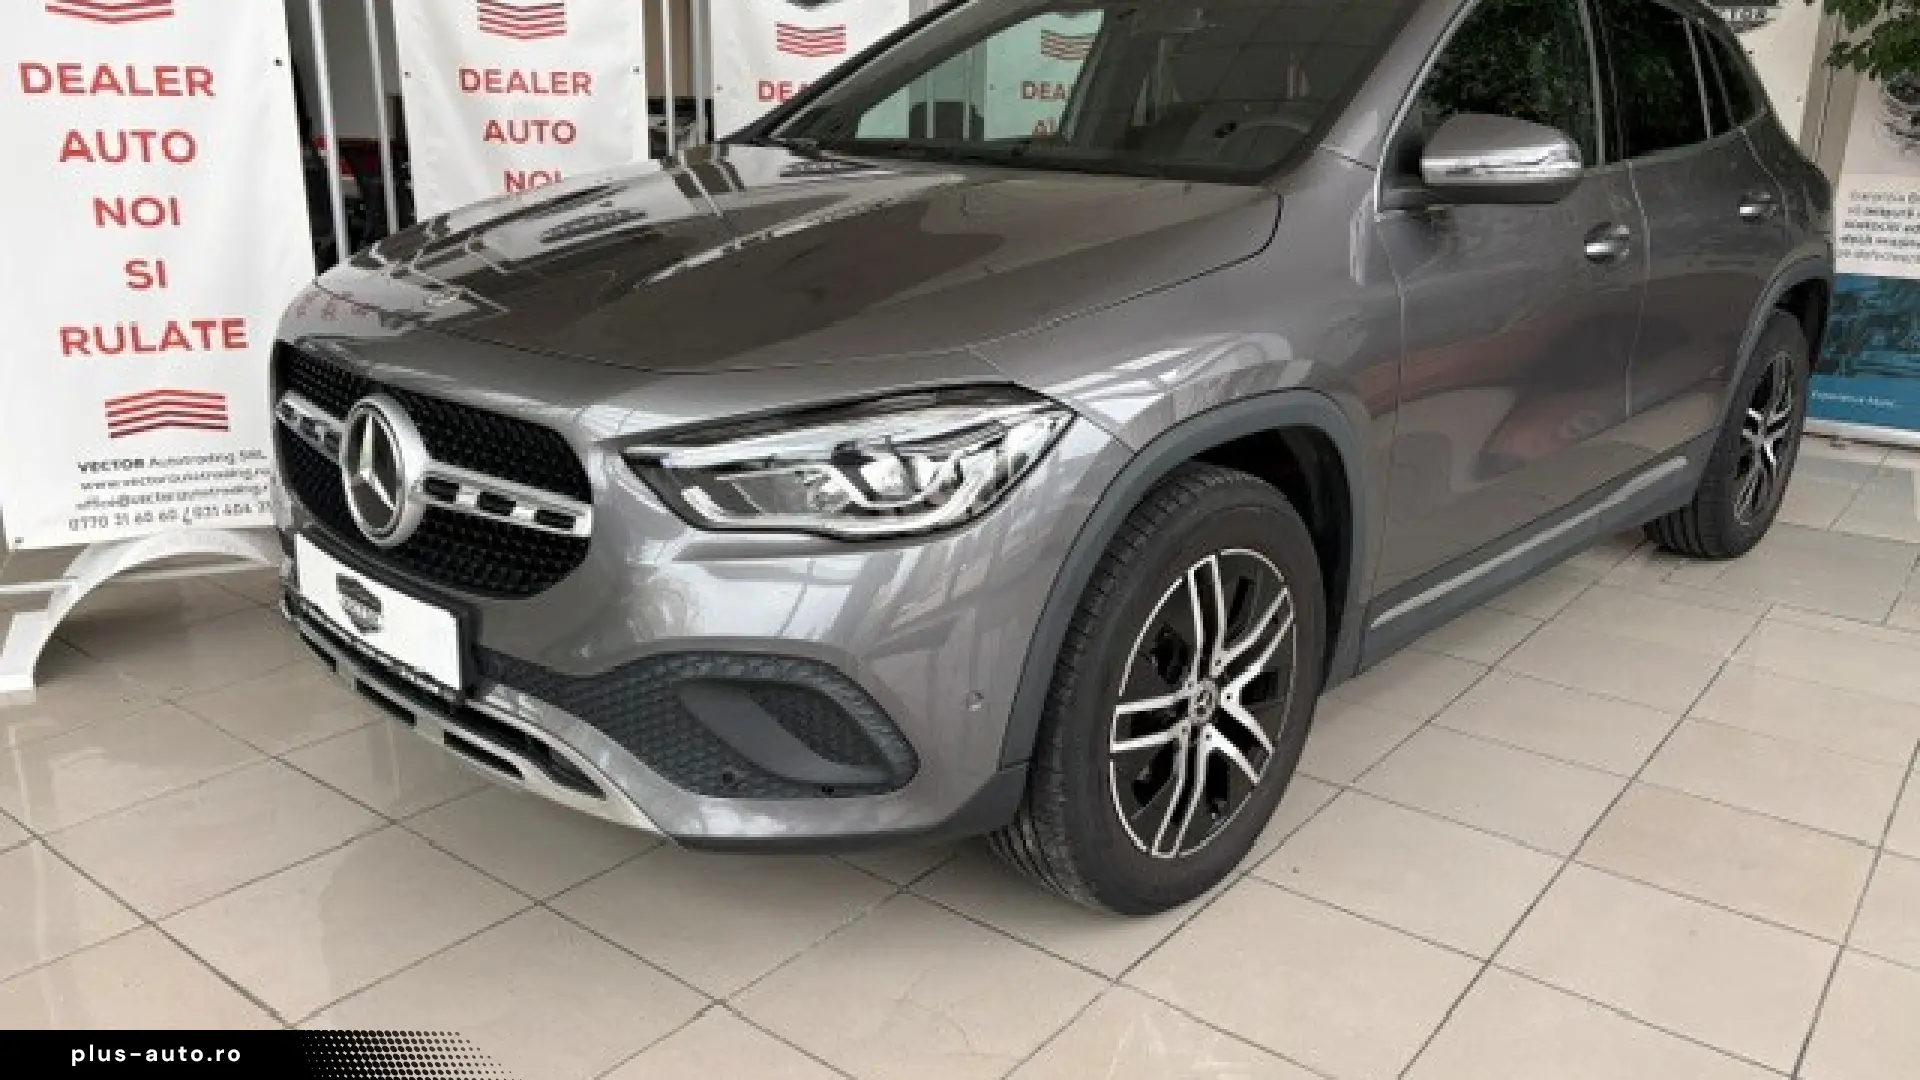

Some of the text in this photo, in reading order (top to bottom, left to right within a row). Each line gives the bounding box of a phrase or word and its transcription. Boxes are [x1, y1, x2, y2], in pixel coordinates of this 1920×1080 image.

[17, 62, 215, 98] DEALER
[459, 67, 592, 97] DEALER
[58, 129, 198, 165] AUTO
[482, 118, 577, 145] AUTO
[92, 195, 182, 228] NOI
[124, 257, 169, 291] SI
[59, 317, 250, 357] RULATE
[77, 457, 145, 475] VECTOR
